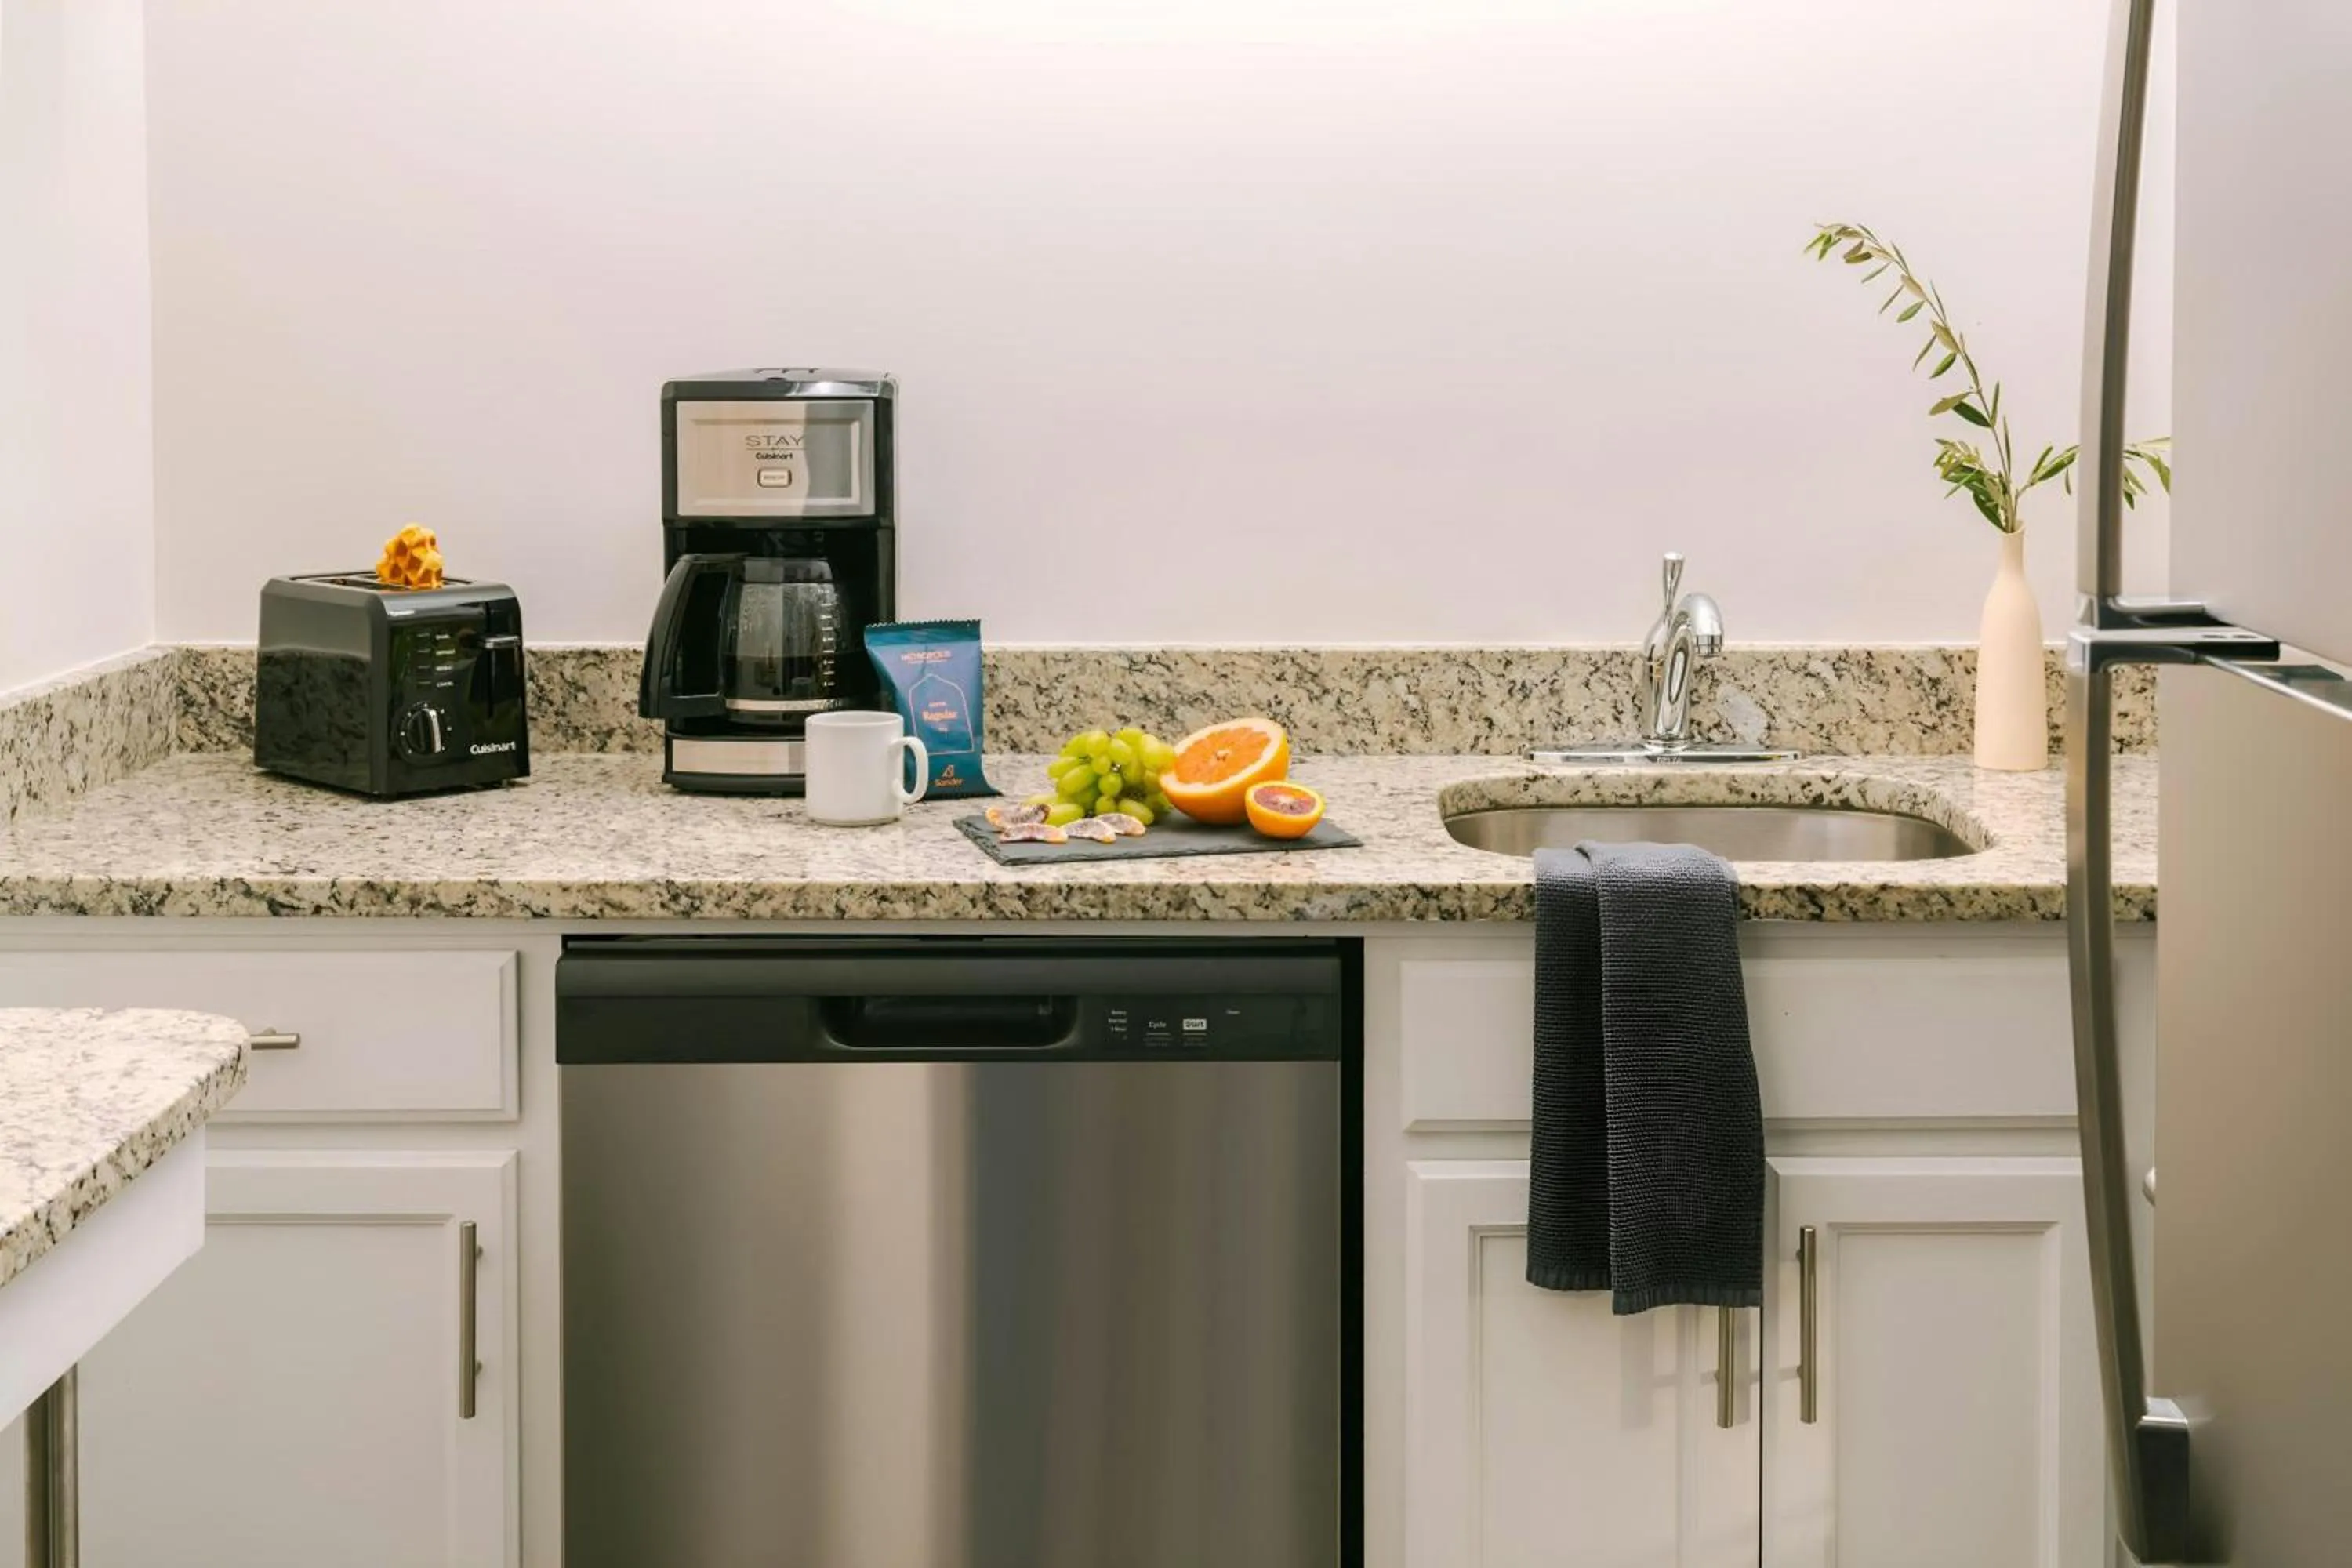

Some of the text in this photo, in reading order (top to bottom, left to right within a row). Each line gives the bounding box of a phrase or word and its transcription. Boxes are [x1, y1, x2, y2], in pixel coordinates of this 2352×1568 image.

[746, 435, 804, 446] STAY
[756, 452, 793, 460] Cuisinart
[470, 741, 516, 754] Cuisinart
